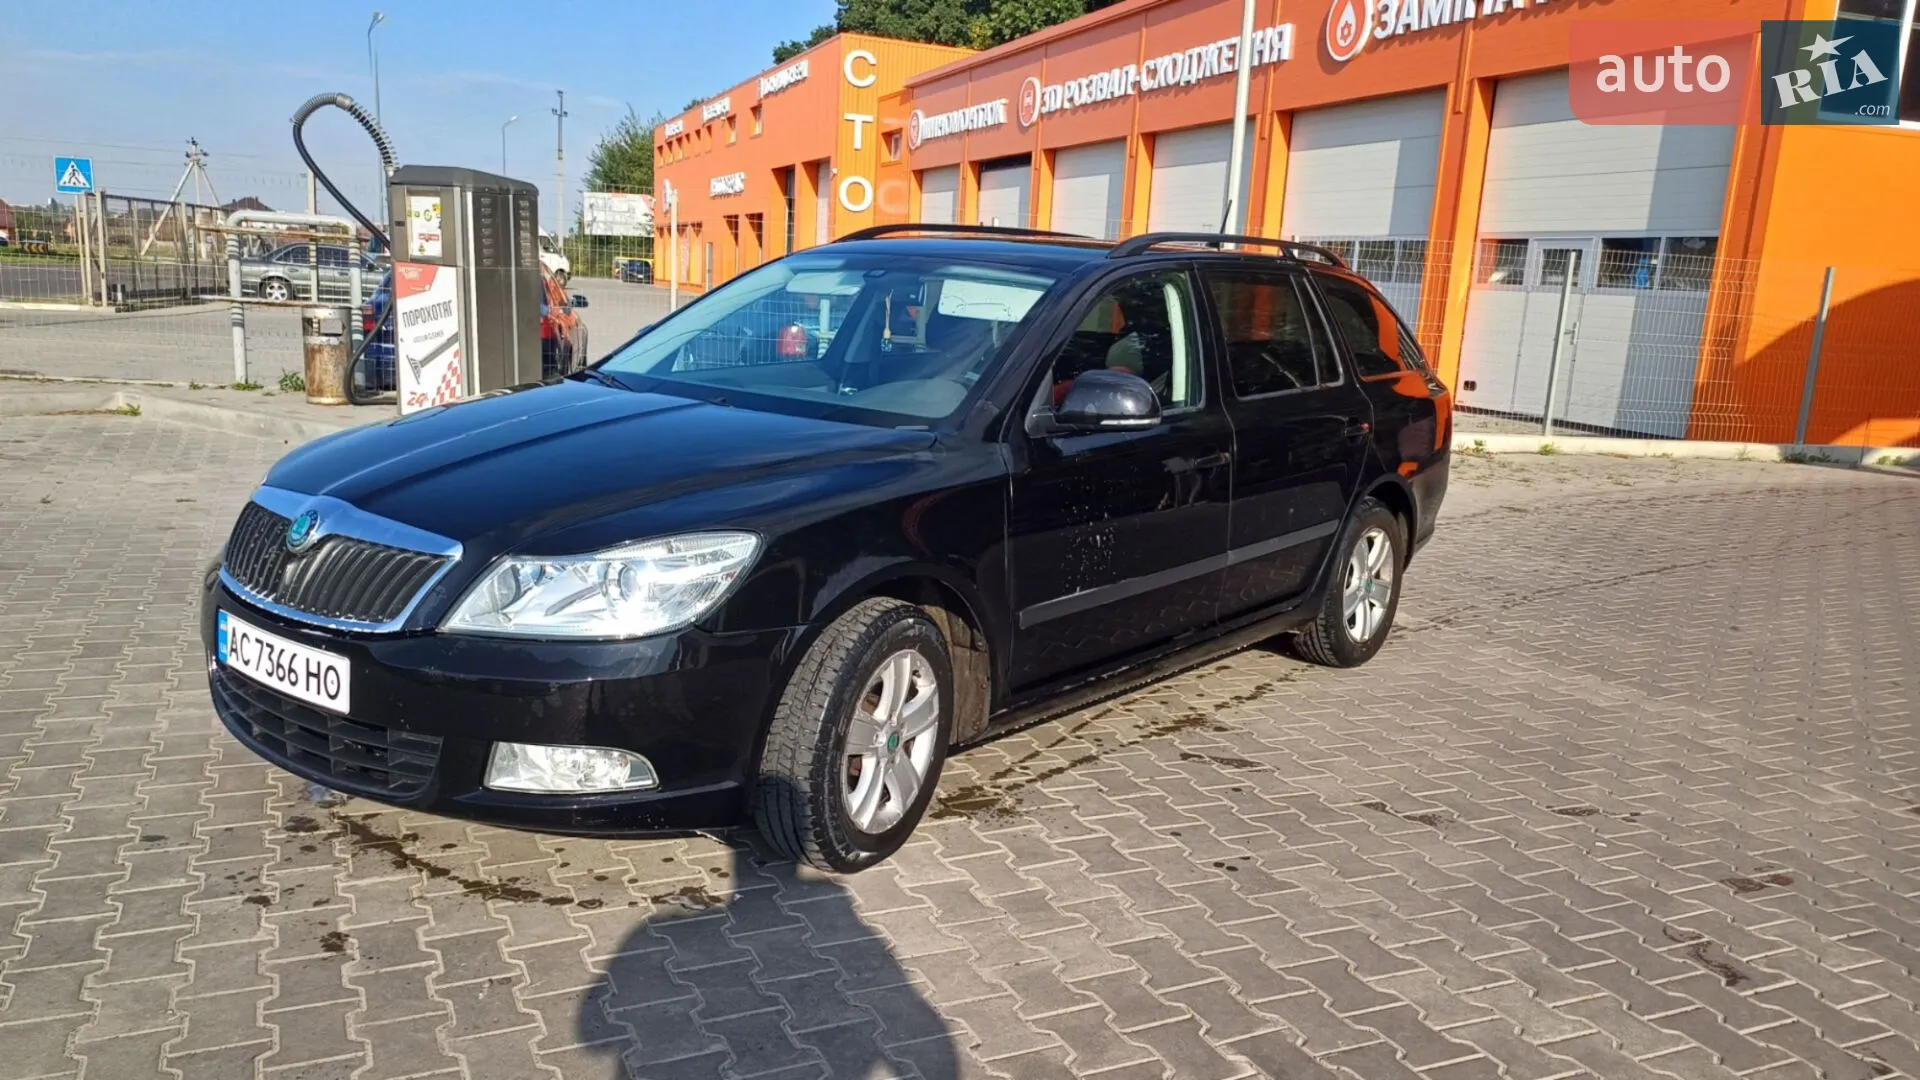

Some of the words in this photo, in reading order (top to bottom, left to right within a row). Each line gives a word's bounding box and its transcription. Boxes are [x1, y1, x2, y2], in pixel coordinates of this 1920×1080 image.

[1374, 0, 1530, 40] ЗАМ
[839, 49, 877, 213] СТО
[402, 299, 453, 329] ПОРОХОТЯГ
[229, 627, 250, 666] AC
[255, 638, 298, 687] 7366
[306, 657, 340, 700] HO
